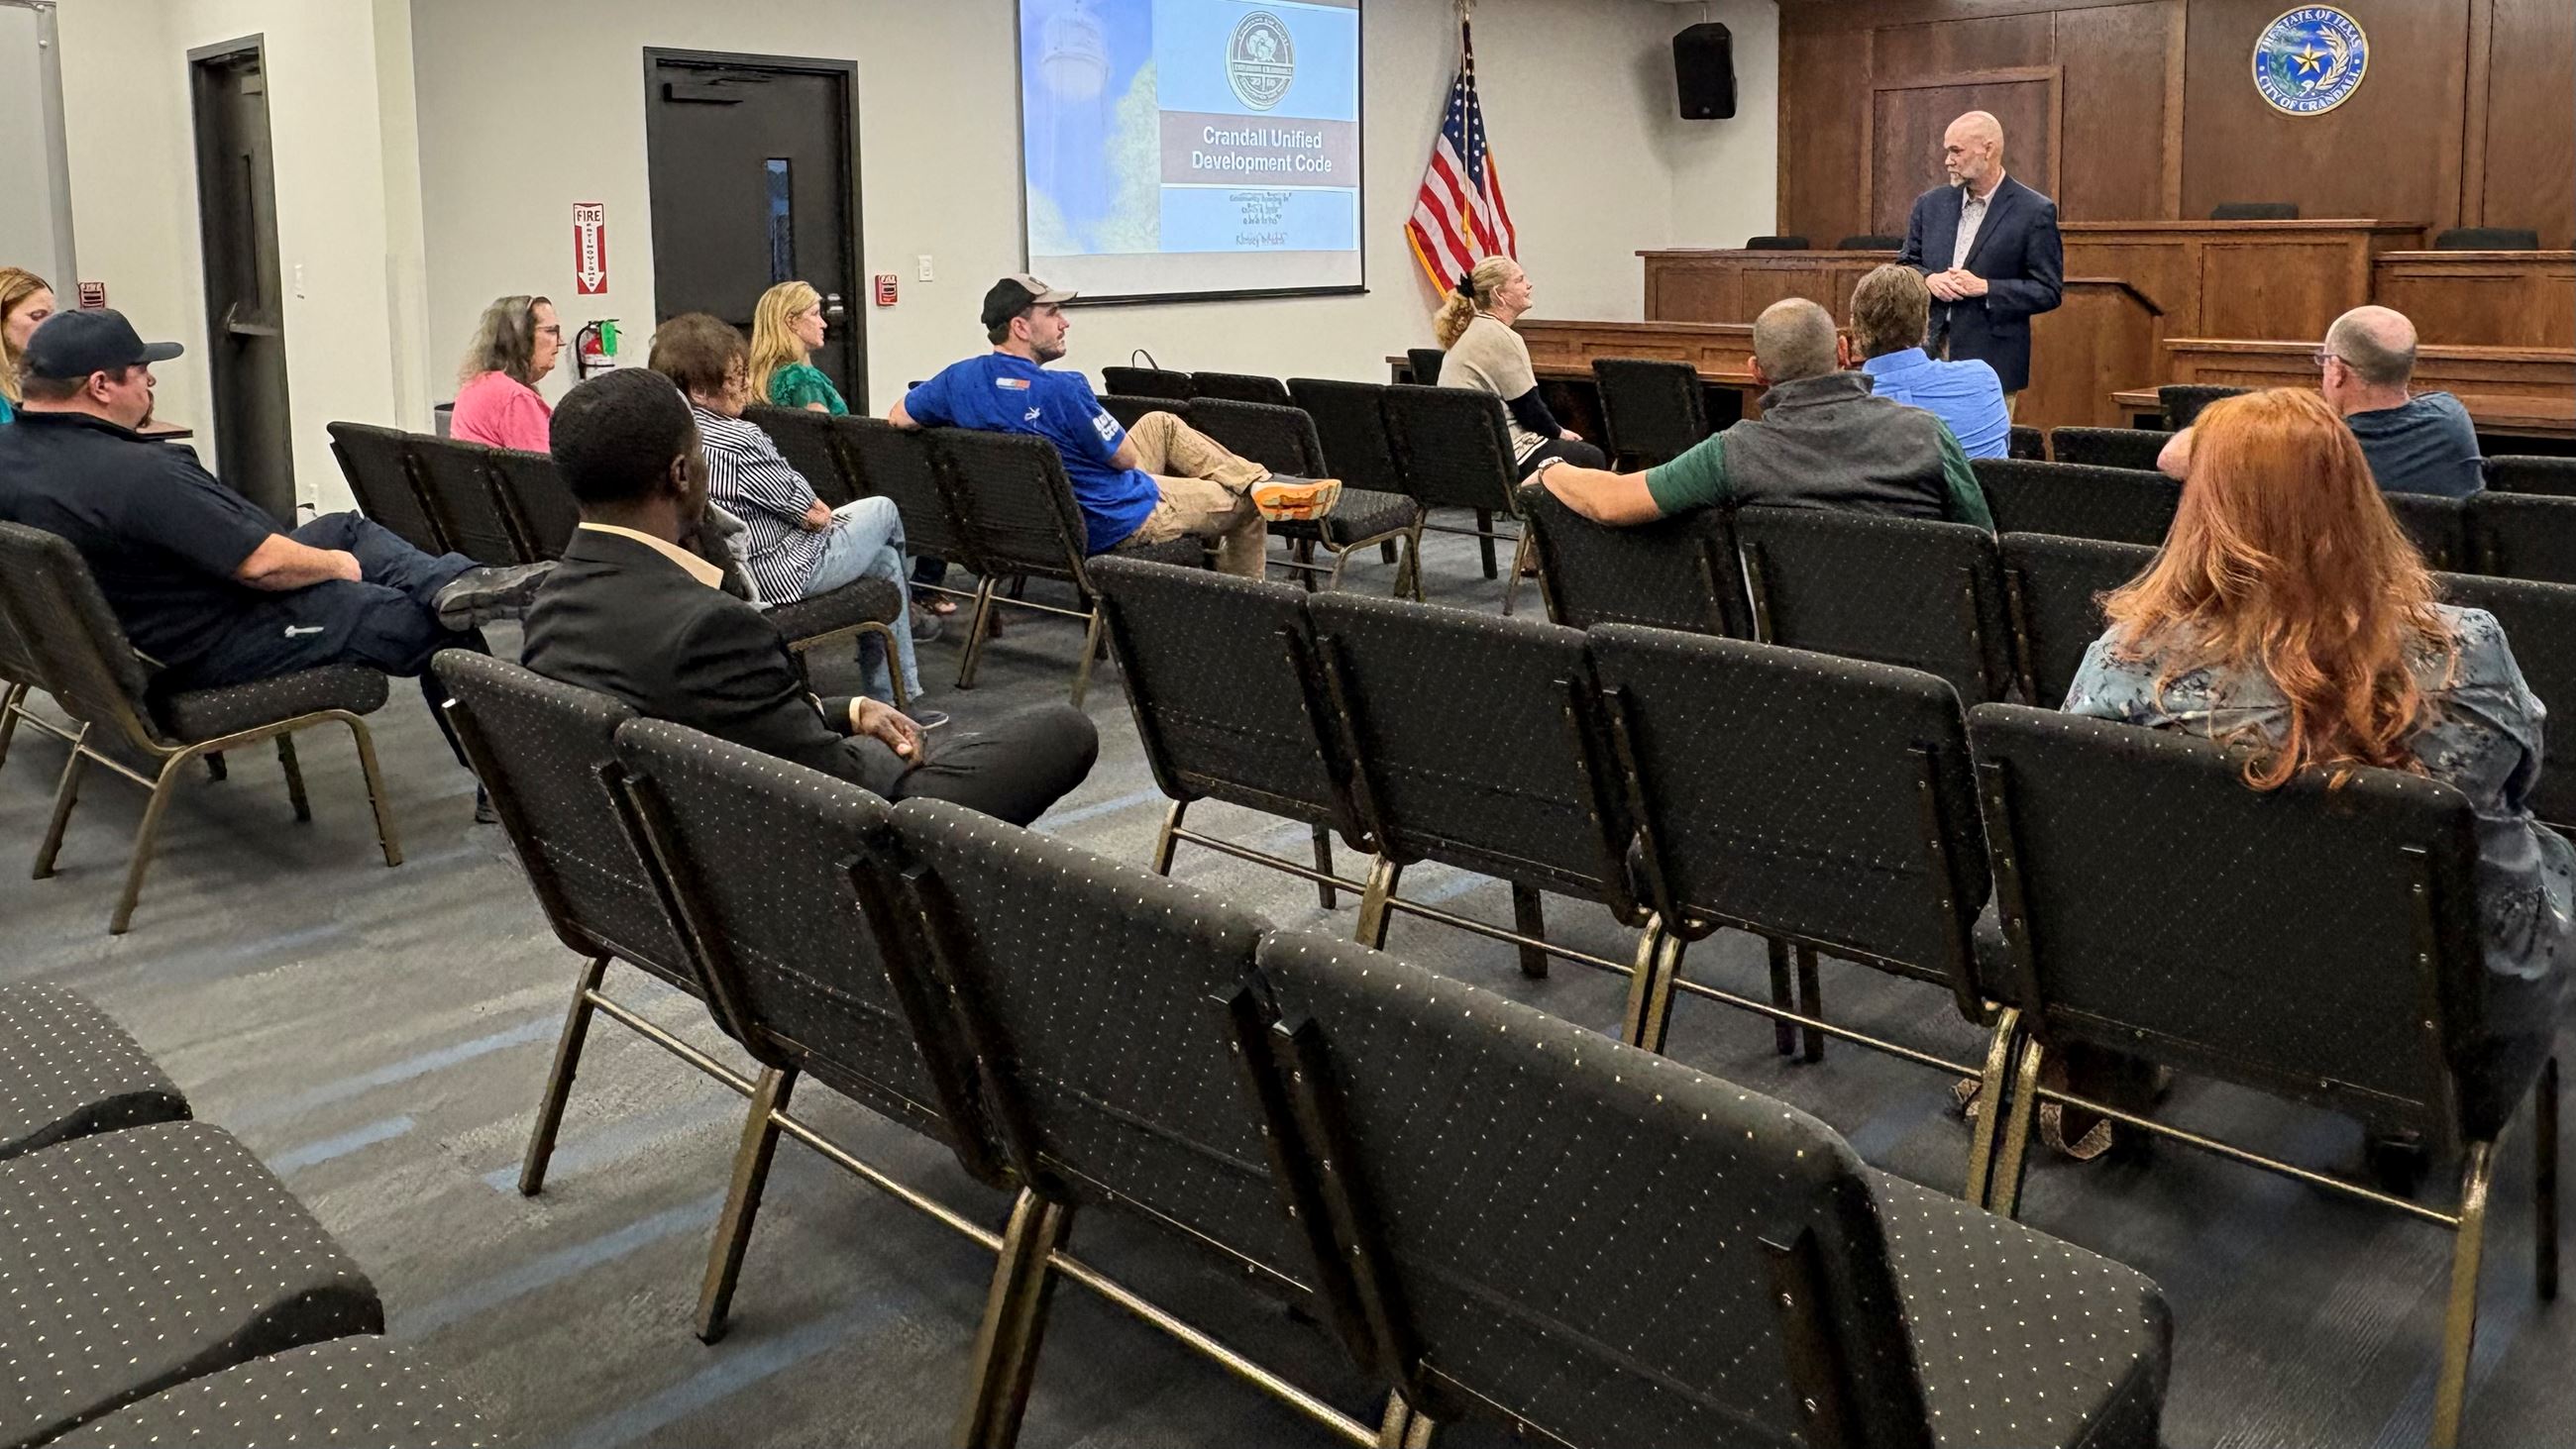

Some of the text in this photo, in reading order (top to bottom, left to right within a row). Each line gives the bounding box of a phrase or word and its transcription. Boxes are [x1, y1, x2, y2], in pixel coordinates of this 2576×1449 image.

[2315, 10, 2333, 20] OF
[2335, 15, 2362, 49] TEXAS
[2259, 69, 2362, 111] CITY OF CRANDALL
[1203, 126, 1323, 149] Crandall Unified
[1192, 151, 1333, 174] Development Code
[577, 210, 600, 222] FIRE
